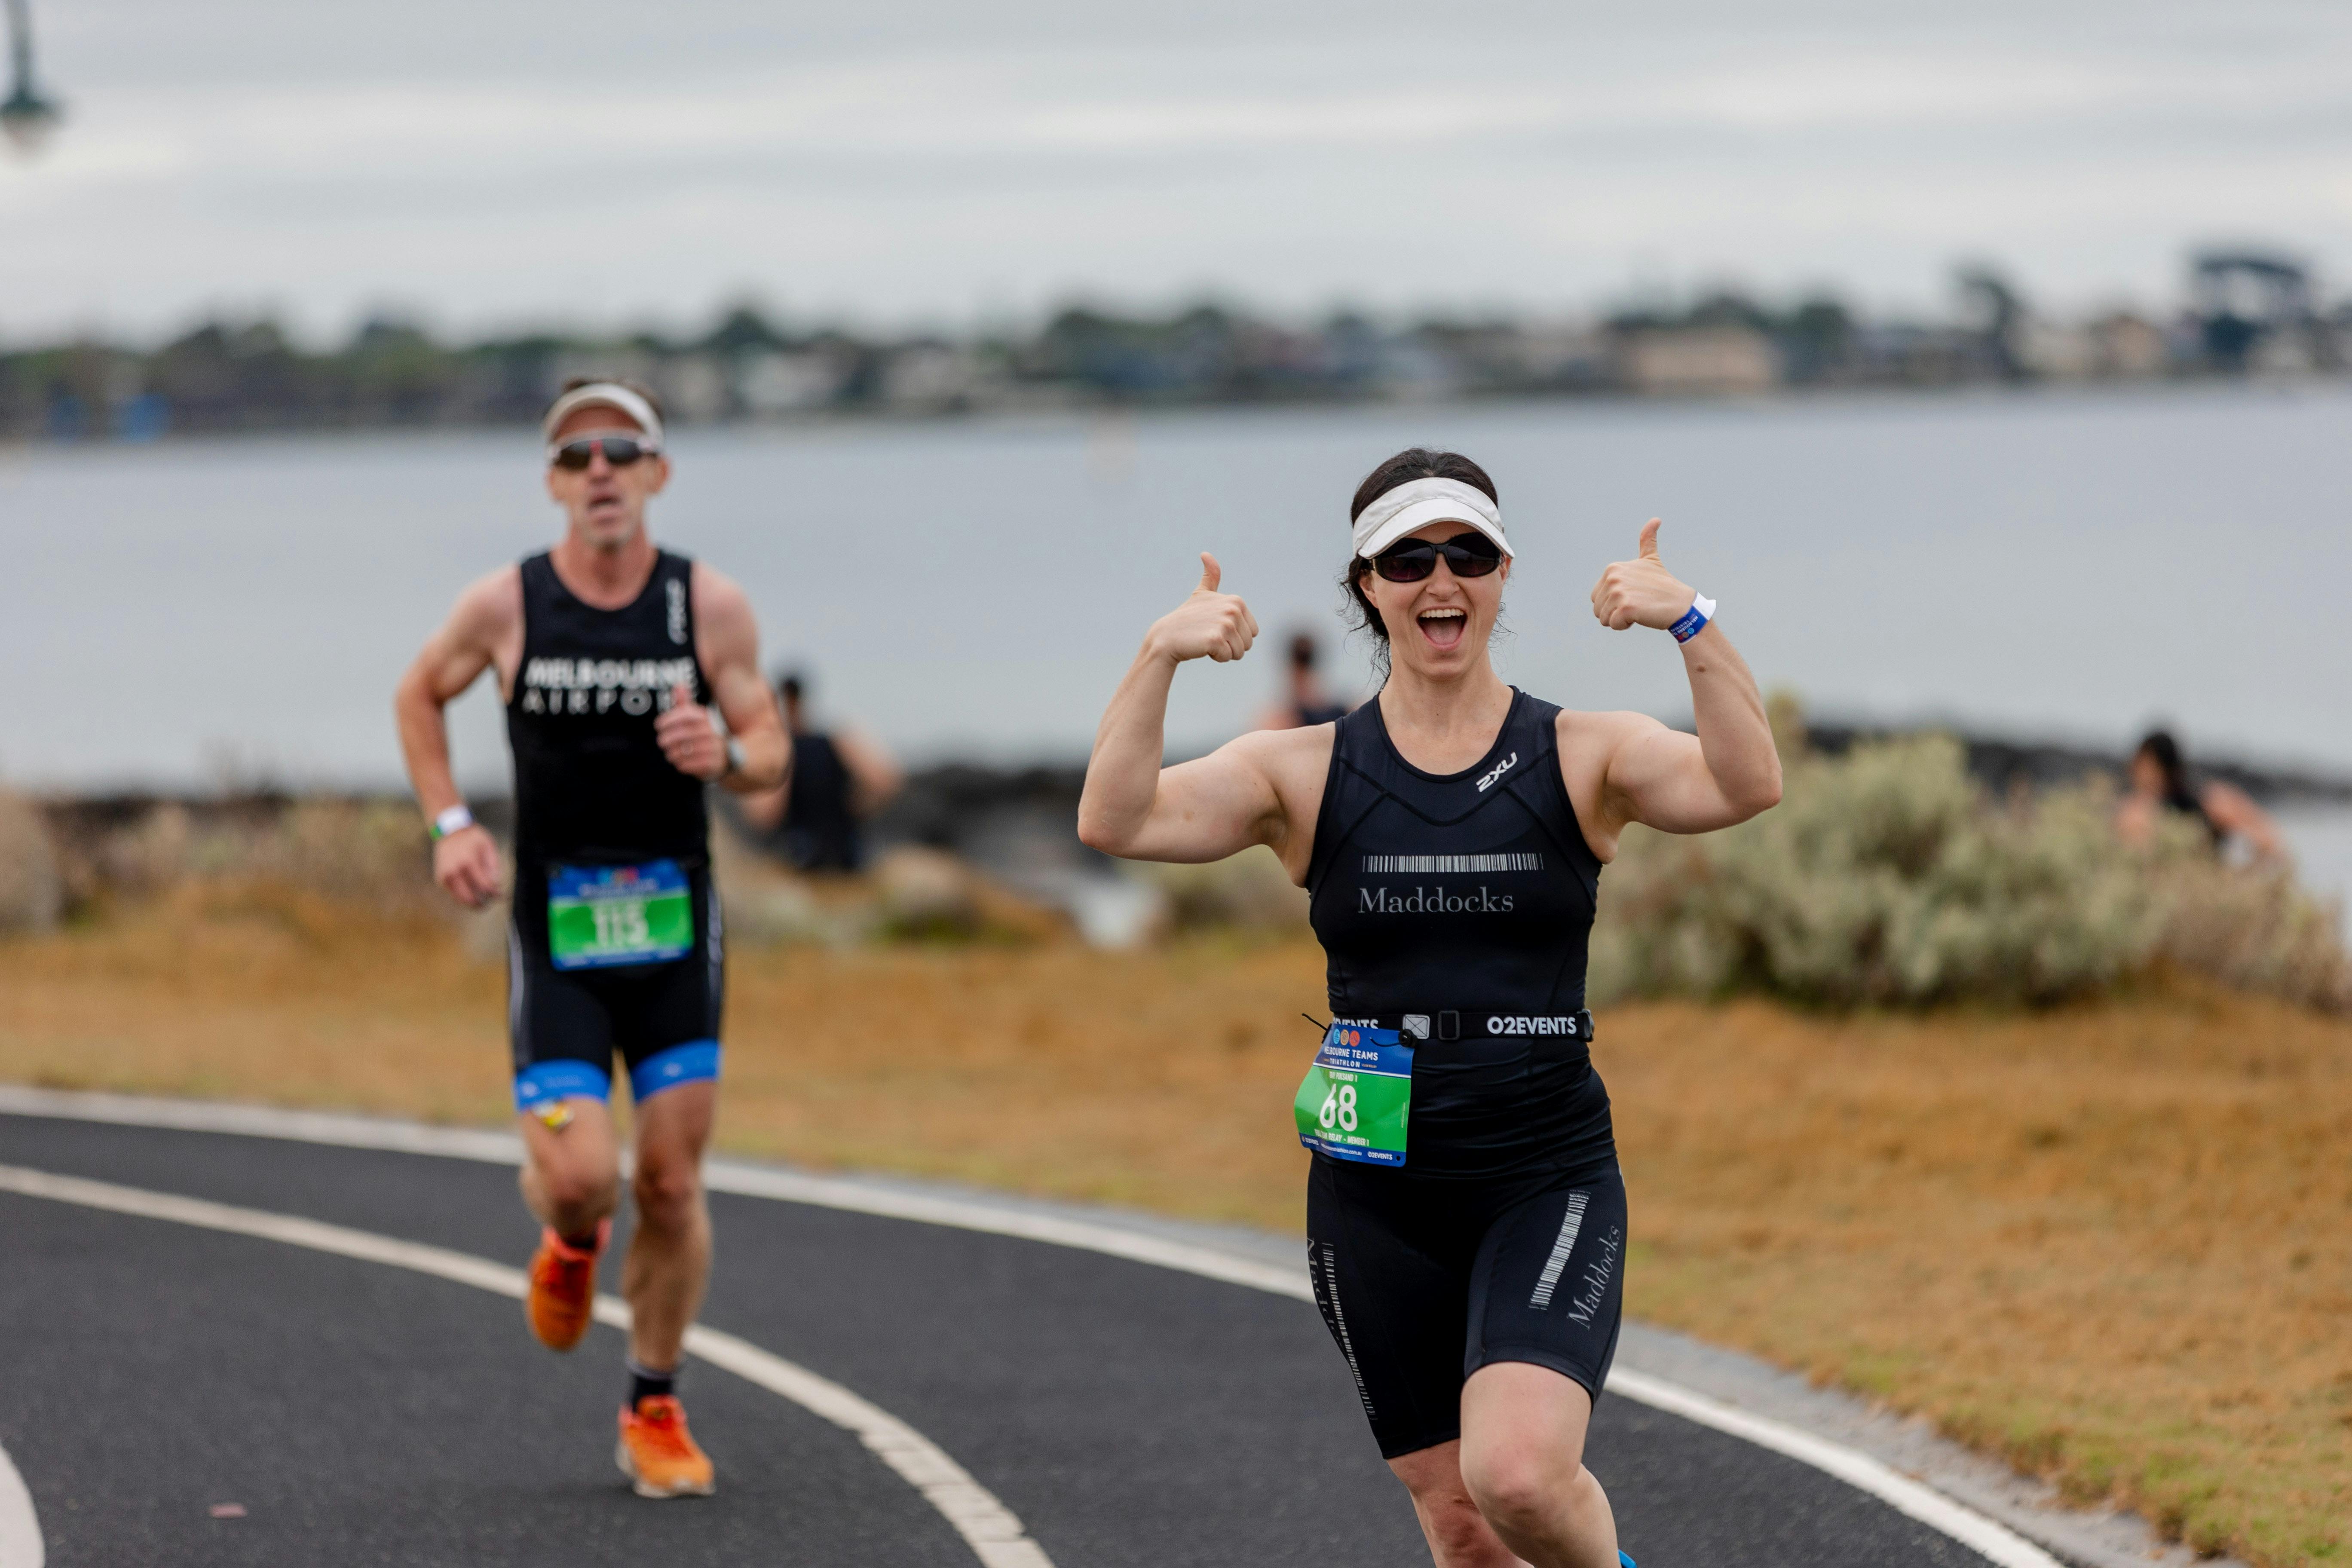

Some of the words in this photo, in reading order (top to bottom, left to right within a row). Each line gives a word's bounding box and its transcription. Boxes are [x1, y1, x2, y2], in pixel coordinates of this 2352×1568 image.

[525, 656, 697, 689] MELBOURNE
[1476, 752, 1517, 793] 2XU
[1358, 886, 1513, 913] Maddocks
[1487, 1016, 1577, 1034] O2EVENTS
[1324, 1046, 1350, 1057] MELBOURNE
[1352, 1049, 1378, 1061] TEAMS
[1329, 1058, 1360, 1068] TRIATHLON
[1320, 1083, 1357, 1131] 68
[1328, 1133, 1342, 1142] RELAY
[1347, 1136, 1366, 1146] MEMBER
[1367, 1151, 1393, 1161] O2EVENTS
[1566, 1225, 1620, 1330] Maddocks
